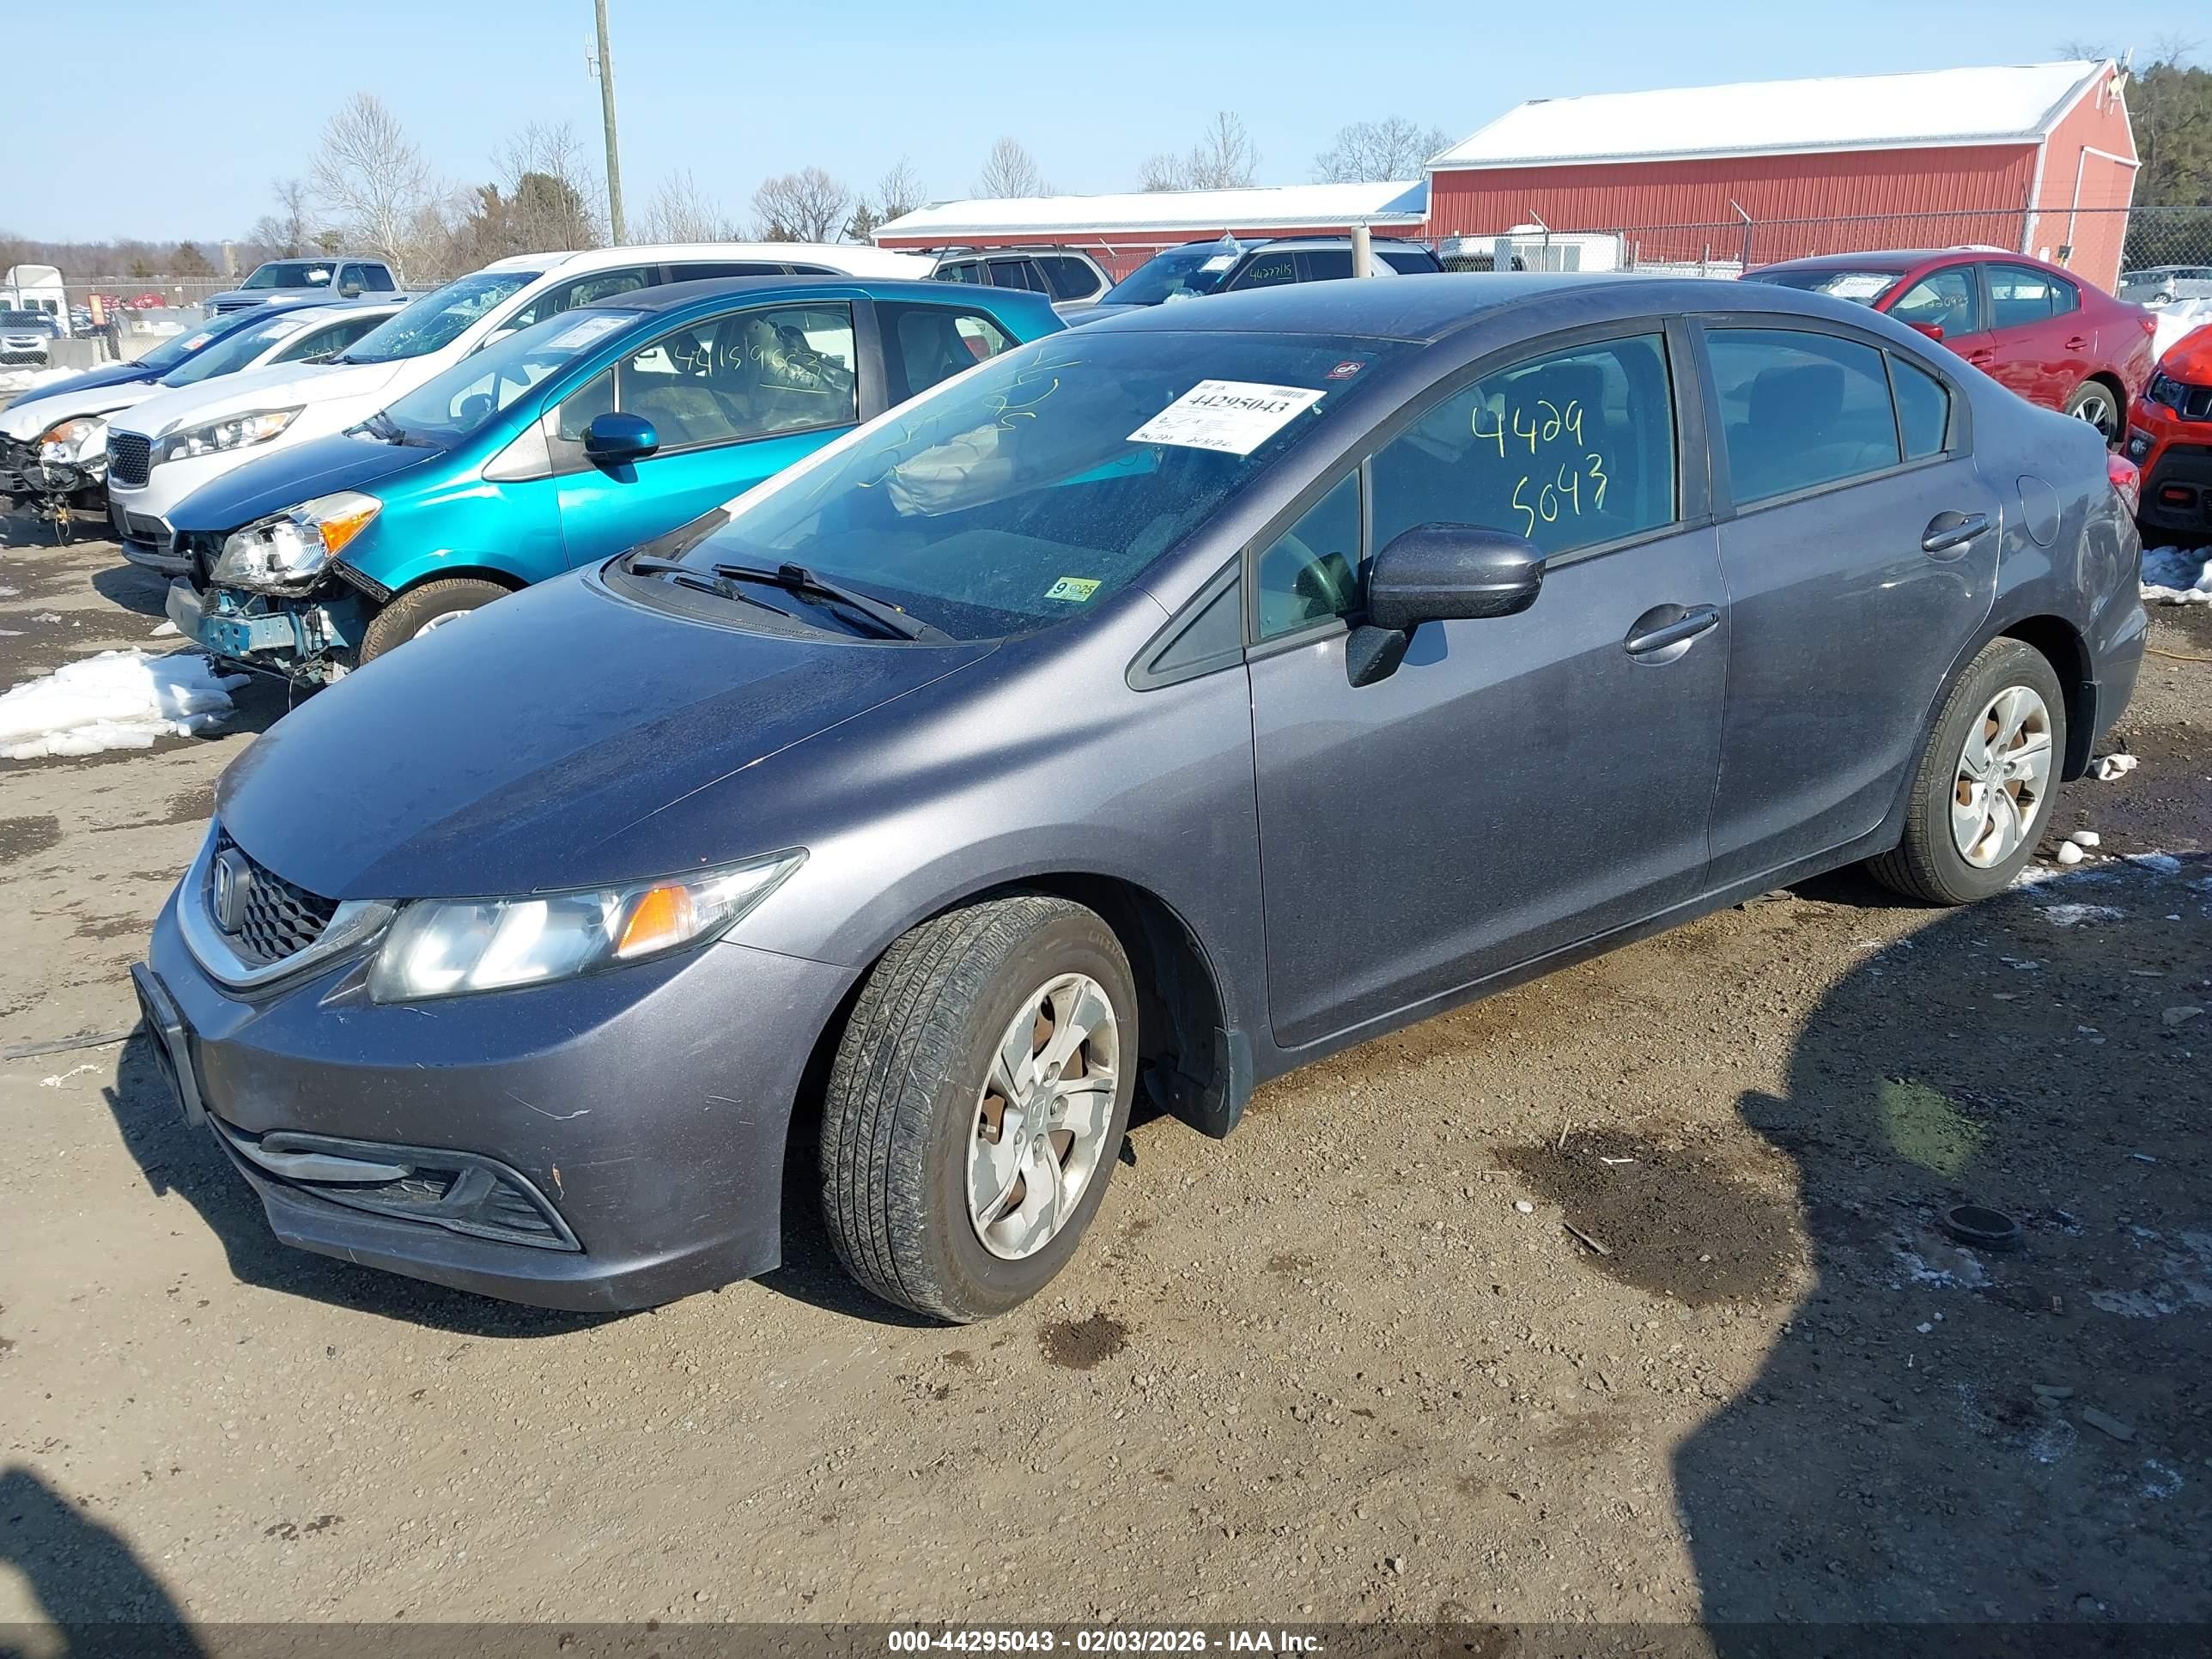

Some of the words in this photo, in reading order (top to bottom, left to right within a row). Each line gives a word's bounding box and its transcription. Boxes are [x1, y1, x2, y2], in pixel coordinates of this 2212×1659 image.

[1189, 393, 1291, 414] 44295043
[1472, 399, 1583, 459] 4429
[1512, 453, 1608, 538] 5043
[1053, 582, 1068, 594] 9
[1079, 584, 1095, 594] 25
